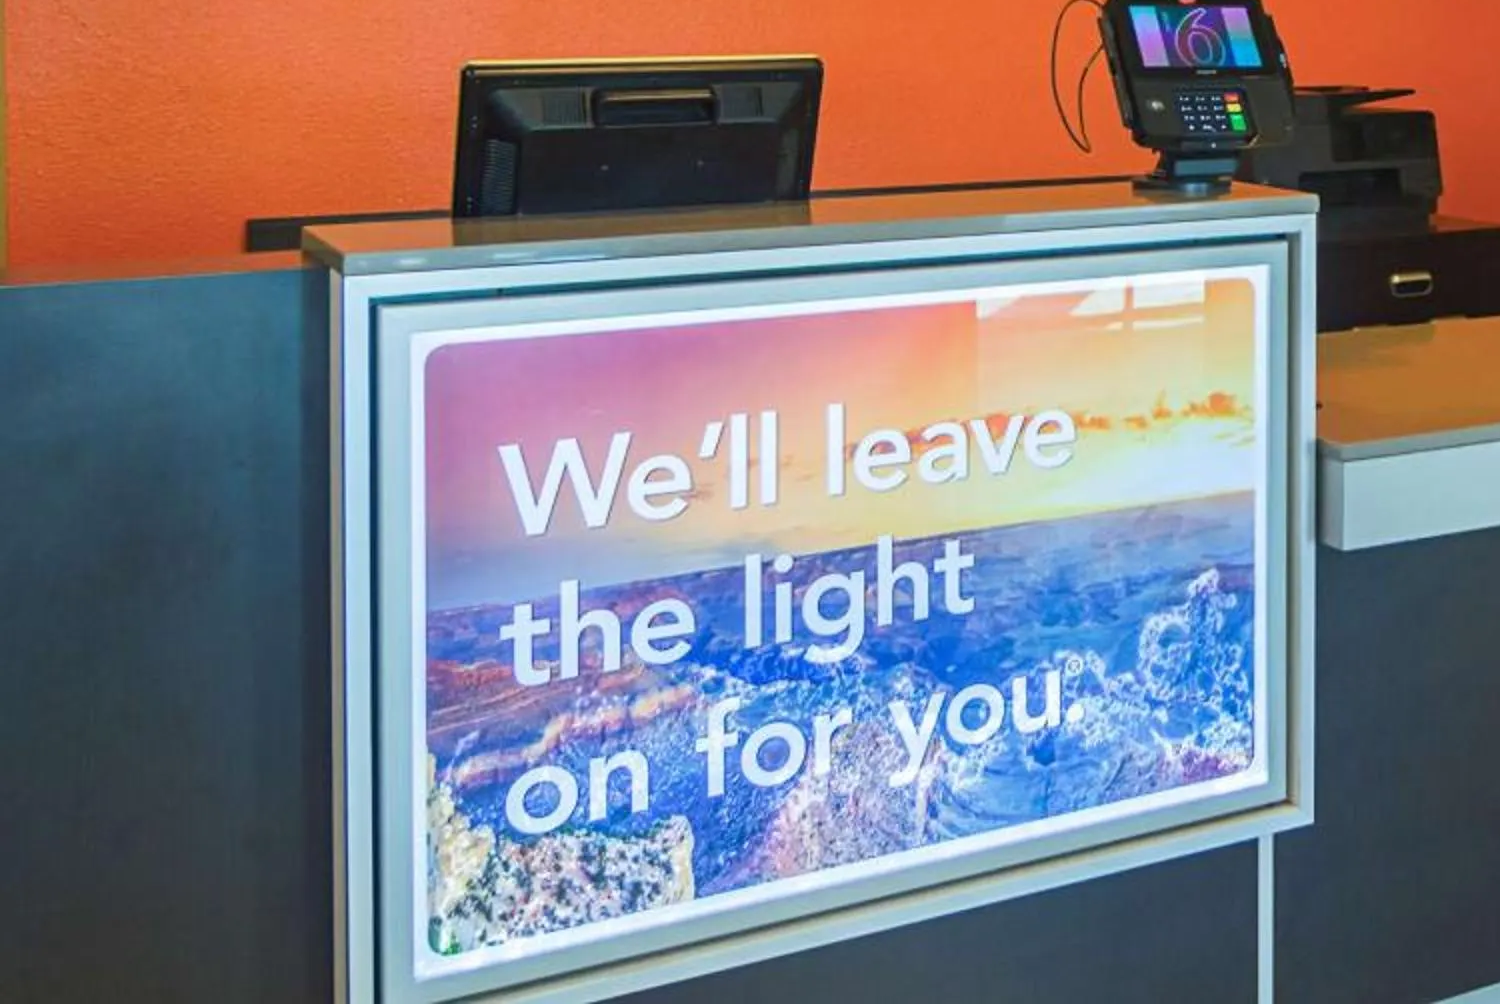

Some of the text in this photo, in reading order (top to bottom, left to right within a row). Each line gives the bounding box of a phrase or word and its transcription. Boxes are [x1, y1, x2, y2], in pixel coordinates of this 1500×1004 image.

[1174, 7, 1226, 67] 6
[826, 403, 1077, 497] leave
[500, 535, 976, 688] the light
[505, 744, 649, 836] on
[696, 699, 853, 798] for
